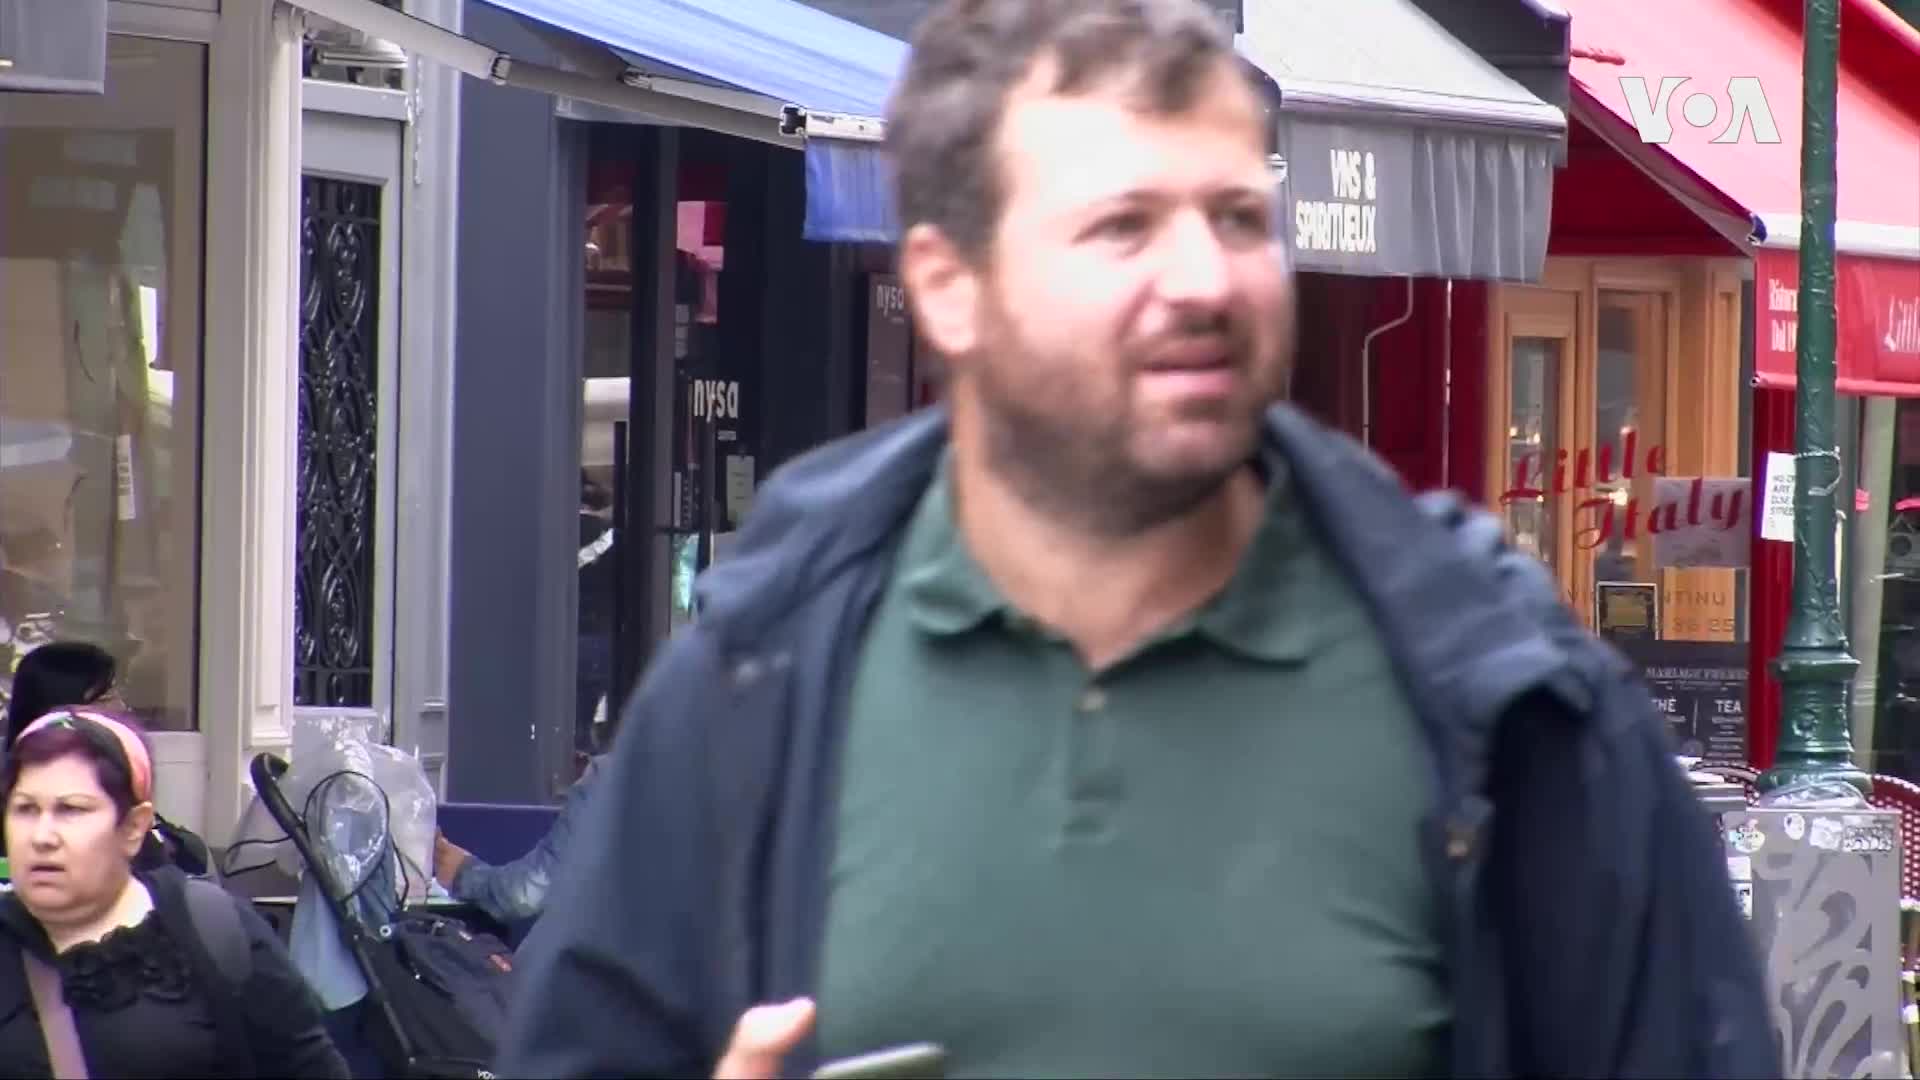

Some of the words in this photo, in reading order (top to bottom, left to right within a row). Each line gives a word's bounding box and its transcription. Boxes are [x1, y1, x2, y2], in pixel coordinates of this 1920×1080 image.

[1296, 200, 1376, 252] SPIRITUEUX
[876, 285, 905, 318] nysa
[694, 379, 739, 423] nysa
[1500, 431, 1664, 505] Little
[1577, 478, 1743, 549] Italy
[1714, 699, 1743, 713] TEA
